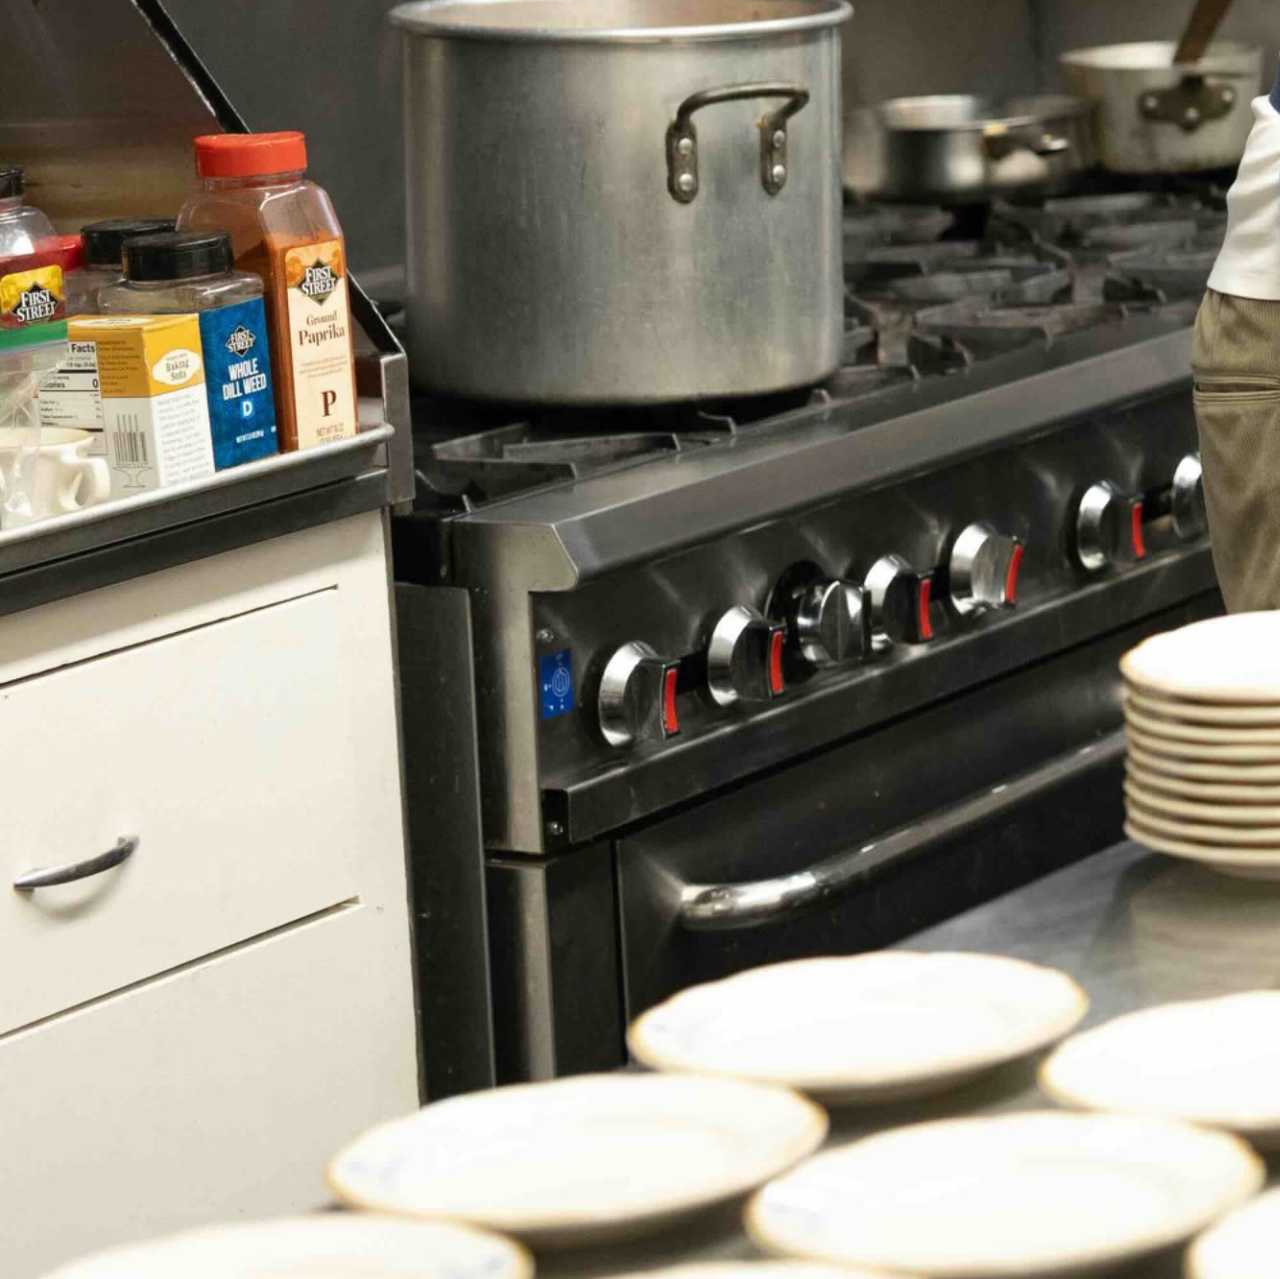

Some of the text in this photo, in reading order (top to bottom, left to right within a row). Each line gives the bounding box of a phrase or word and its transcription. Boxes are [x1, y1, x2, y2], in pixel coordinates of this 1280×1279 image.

[305, 266, 332, 282] FIRST
[301, 278, 336, 296] STREET
[21, 289, 51, 307] FIRST
[16, 301, 56, 322] STREET
[306, 310, 338, 326] Ground
[298, 323, 345, 347] Paprika
[71, 343, 96, 353] Facts
[228, 358, 259, 381] WHOLE
[92, 378, 98, 389] 0
[222, 373, 267, 400] DILL WEED
[242, 400, 253, 417] D
[320, 389, 337, 417] P
